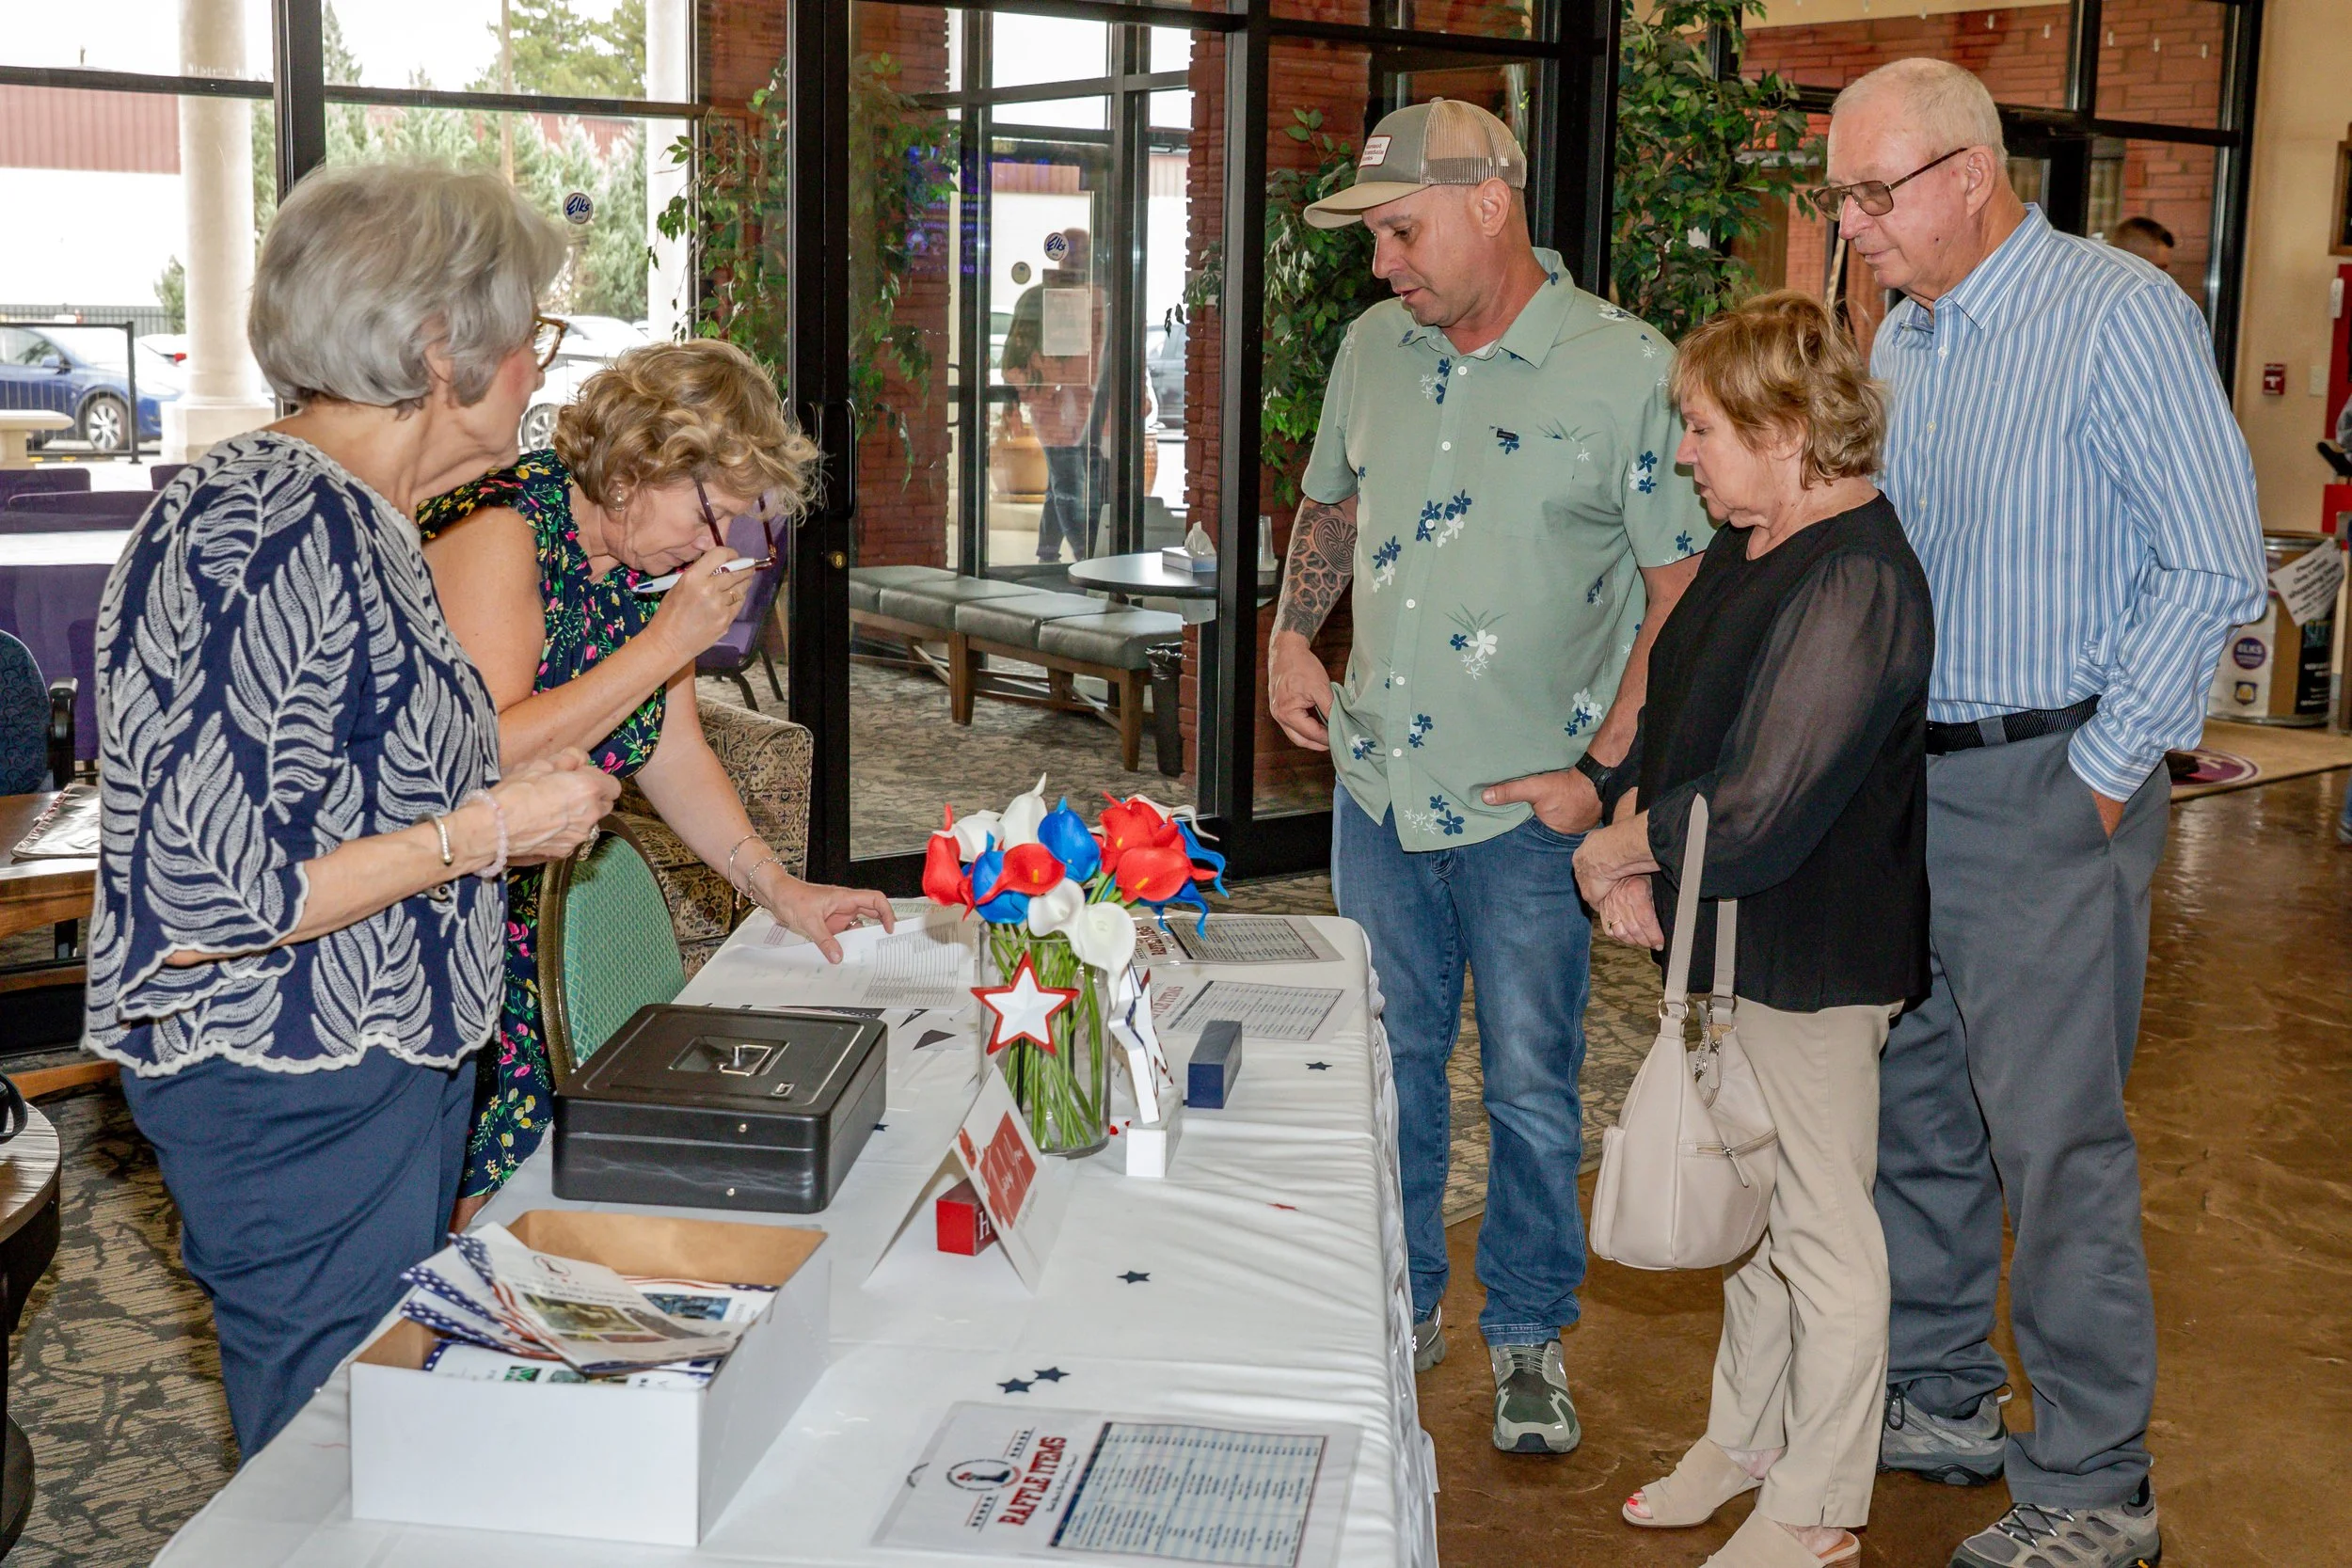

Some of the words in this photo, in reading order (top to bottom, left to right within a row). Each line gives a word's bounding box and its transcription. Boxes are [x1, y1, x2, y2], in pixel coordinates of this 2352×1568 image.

[566, 197, 590, 215] Elks
[1046, 236, 1066, 251] Elks
[997, 1476, 1051, 1526] RAFFLE
[1028, 1436, 1067, 1475] ITEMS
